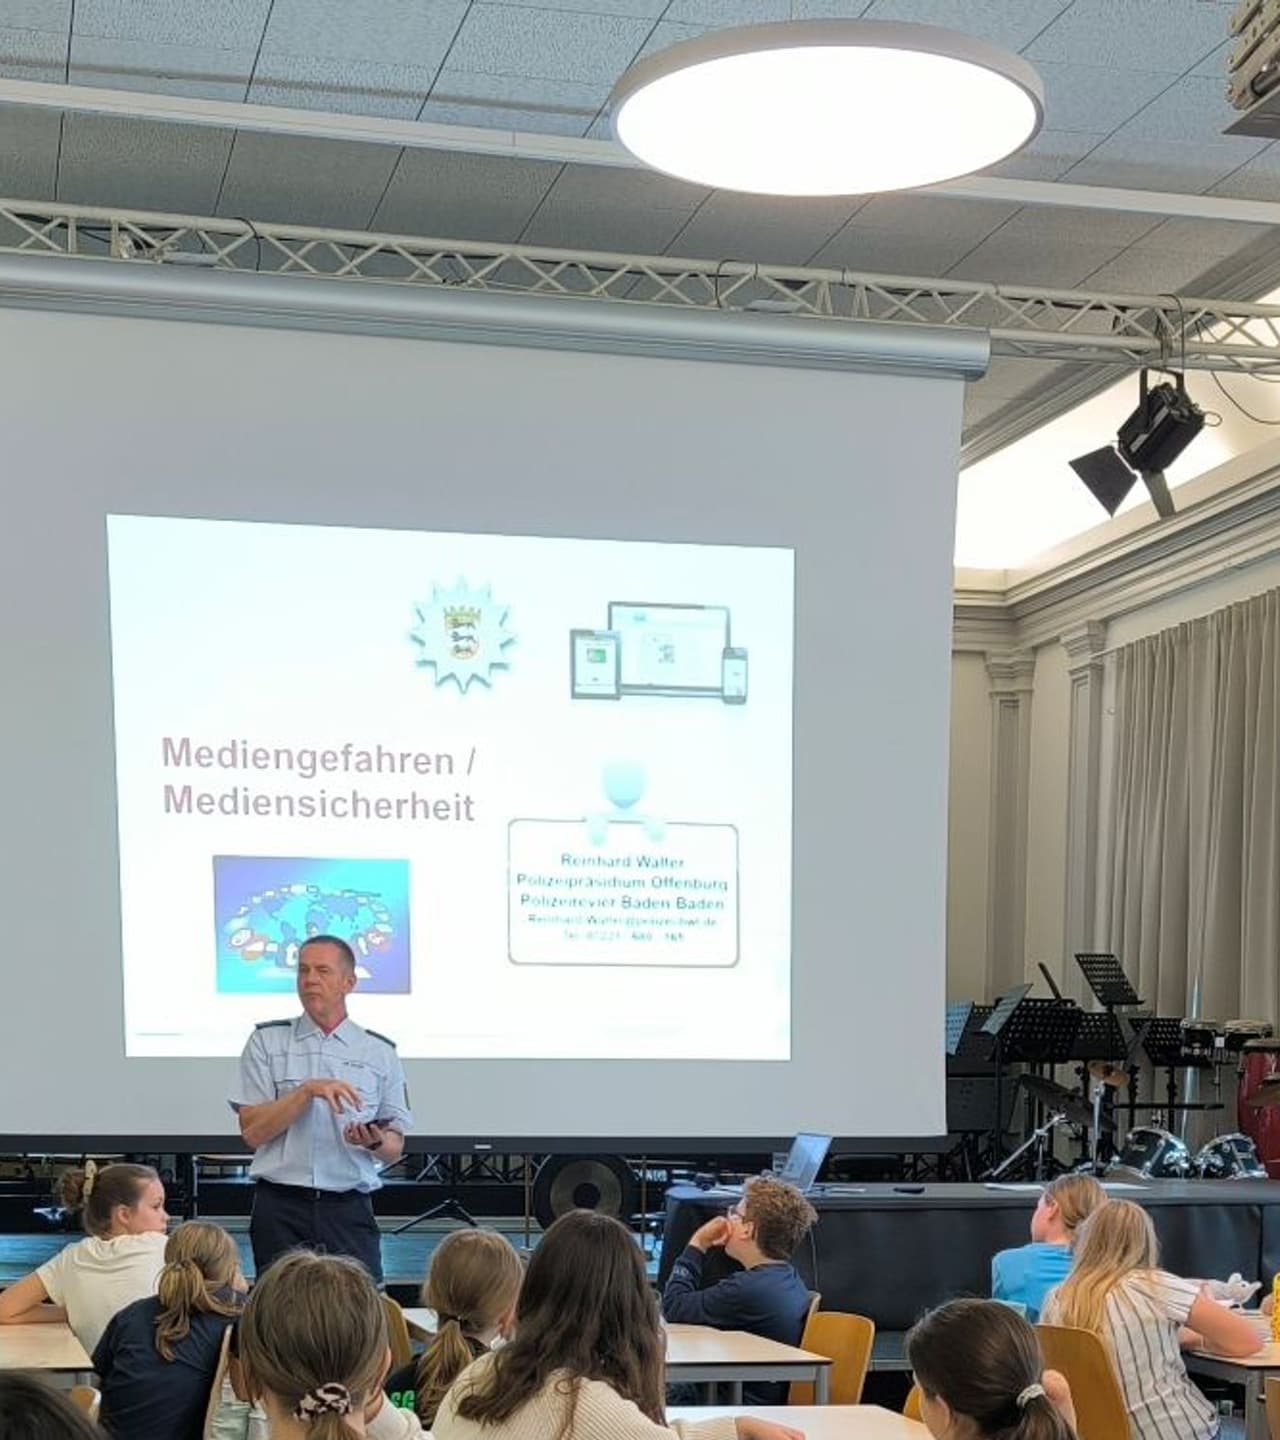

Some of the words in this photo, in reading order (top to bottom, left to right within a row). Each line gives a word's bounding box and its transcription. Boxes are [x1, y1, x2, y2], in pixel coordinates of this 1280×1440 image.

[161, 736, 454, 779] Mediengefahren
[467, 746, 477, 777] /
[163, 783, 476, 822] Mediensicherheit
[560, 853, 631, 868] Reinhard
[636, 856, 685, 869] Walter
[651, 876, 729, 892] Offenburg
